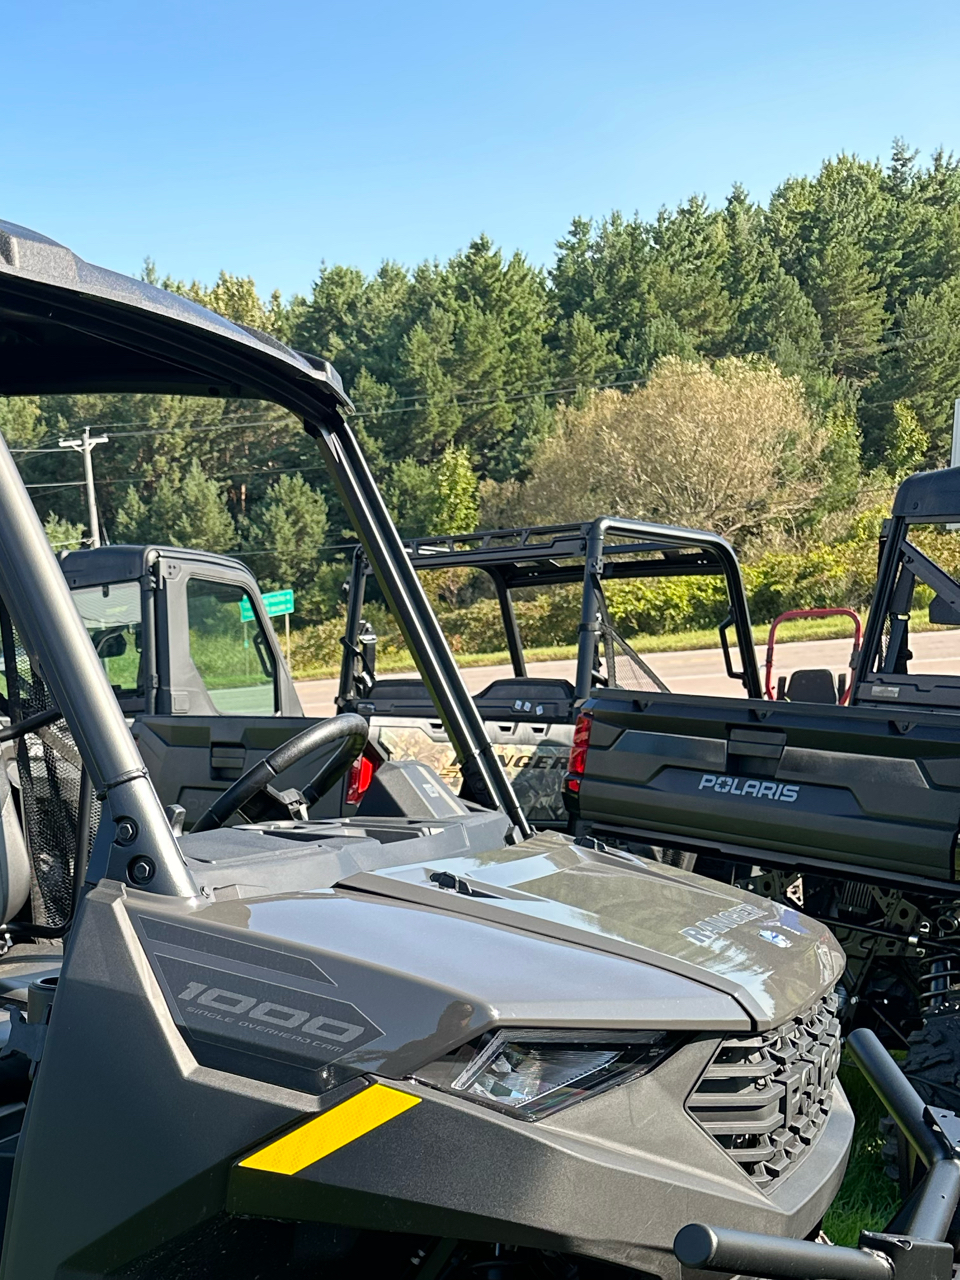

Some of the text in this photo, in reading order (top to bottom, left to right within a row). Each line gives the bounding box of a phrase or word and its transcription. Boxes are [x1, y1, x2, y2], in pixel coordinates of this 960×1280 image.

[698, 774, 800, 802] POLARIS
[678, 903, 769, 946] RANGER
[178, 981, 365, 1043] 1000
[185, 1006, 344, 1053] SINGLE OVERHEAD CAM
